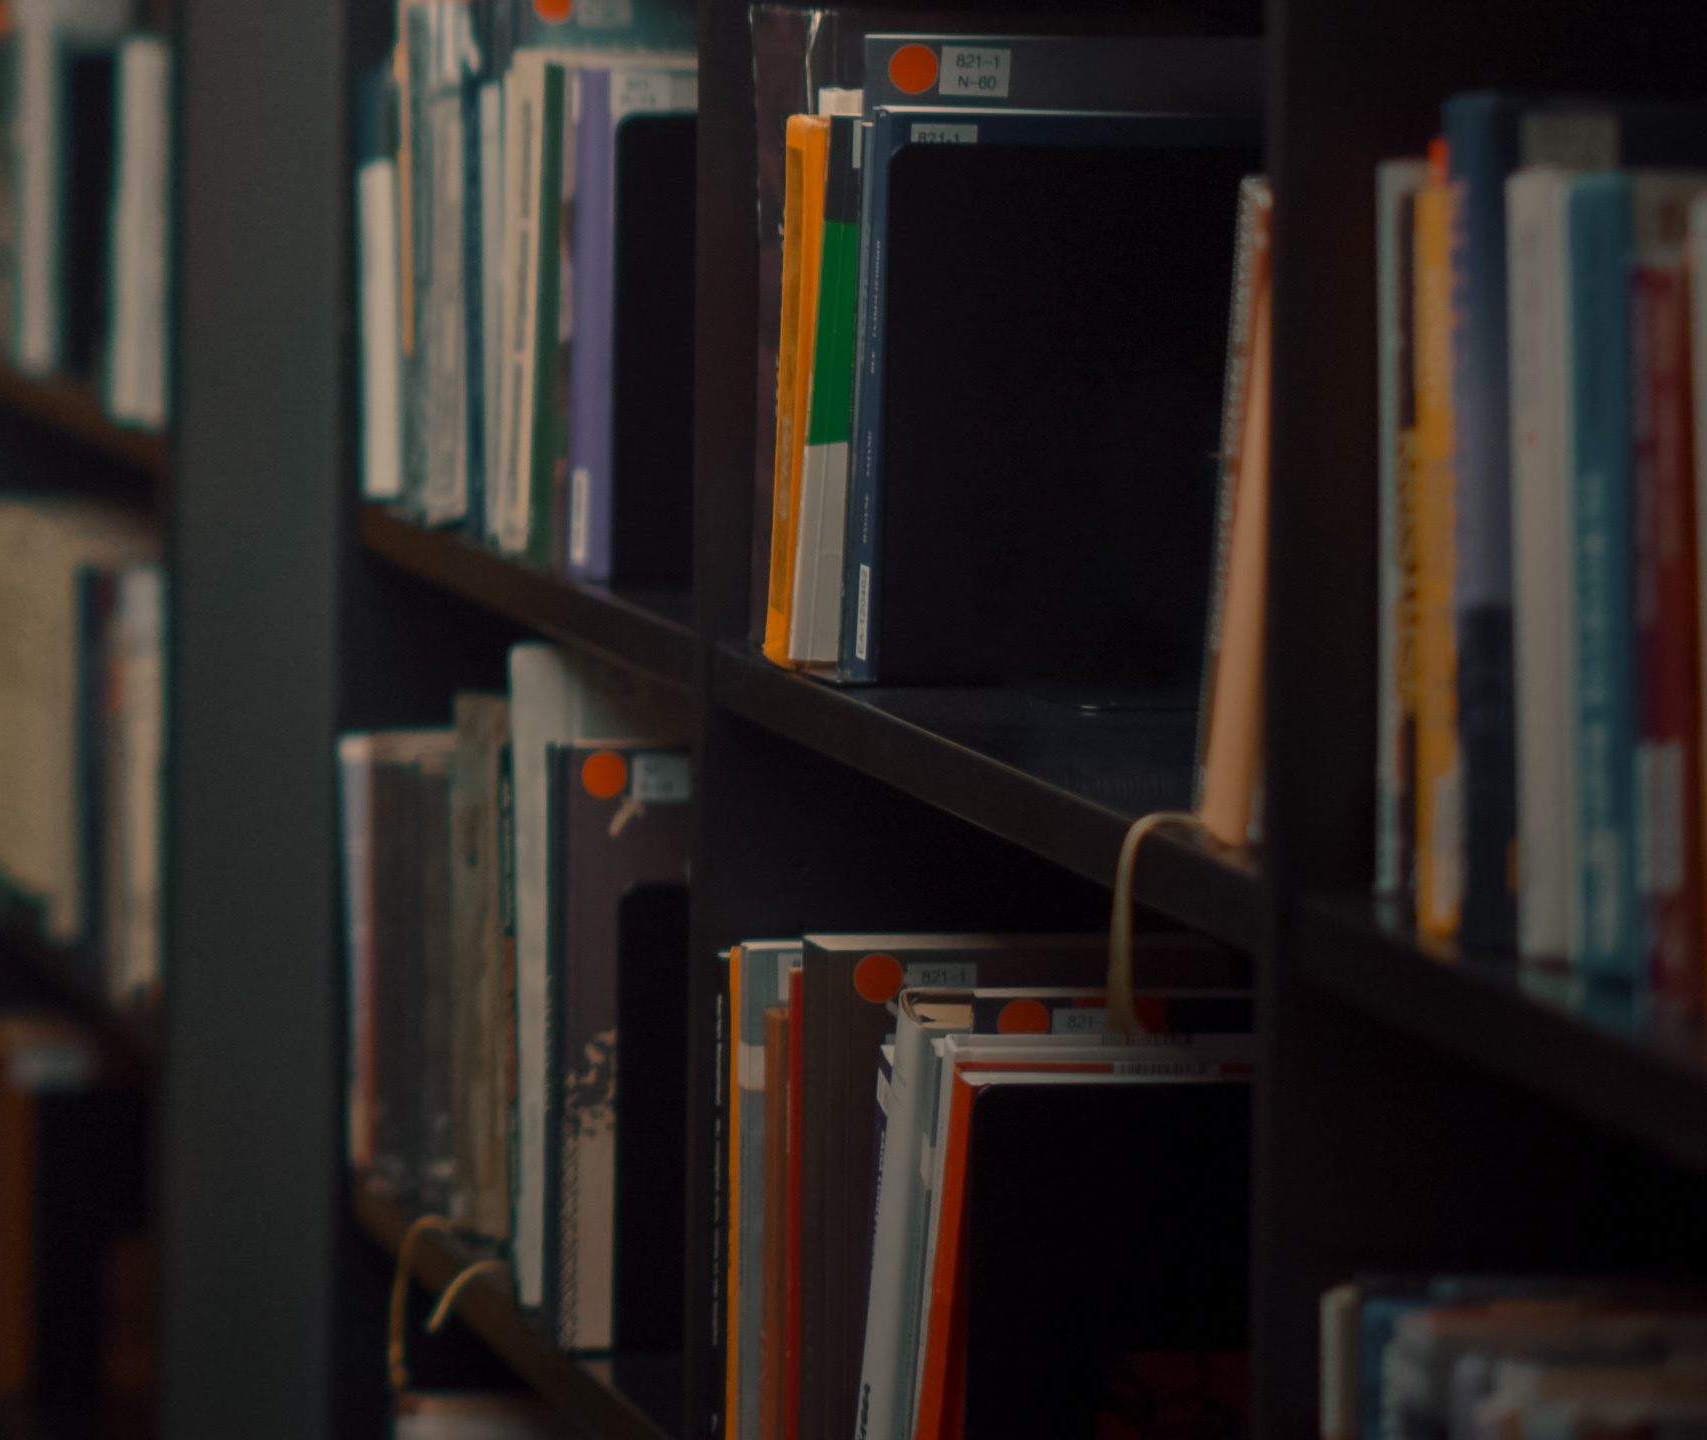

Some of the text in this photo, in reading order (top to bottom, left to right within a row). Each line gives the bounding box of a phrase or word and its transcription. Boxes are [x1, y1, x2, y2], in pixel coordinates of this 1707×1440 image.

[956, 54, 1000, 69] 821-1
[958, 75, 996, 89] N-60
[922, 969, 967, 983] 821-1
[1067, 1016, 1108, 1029] 821-
